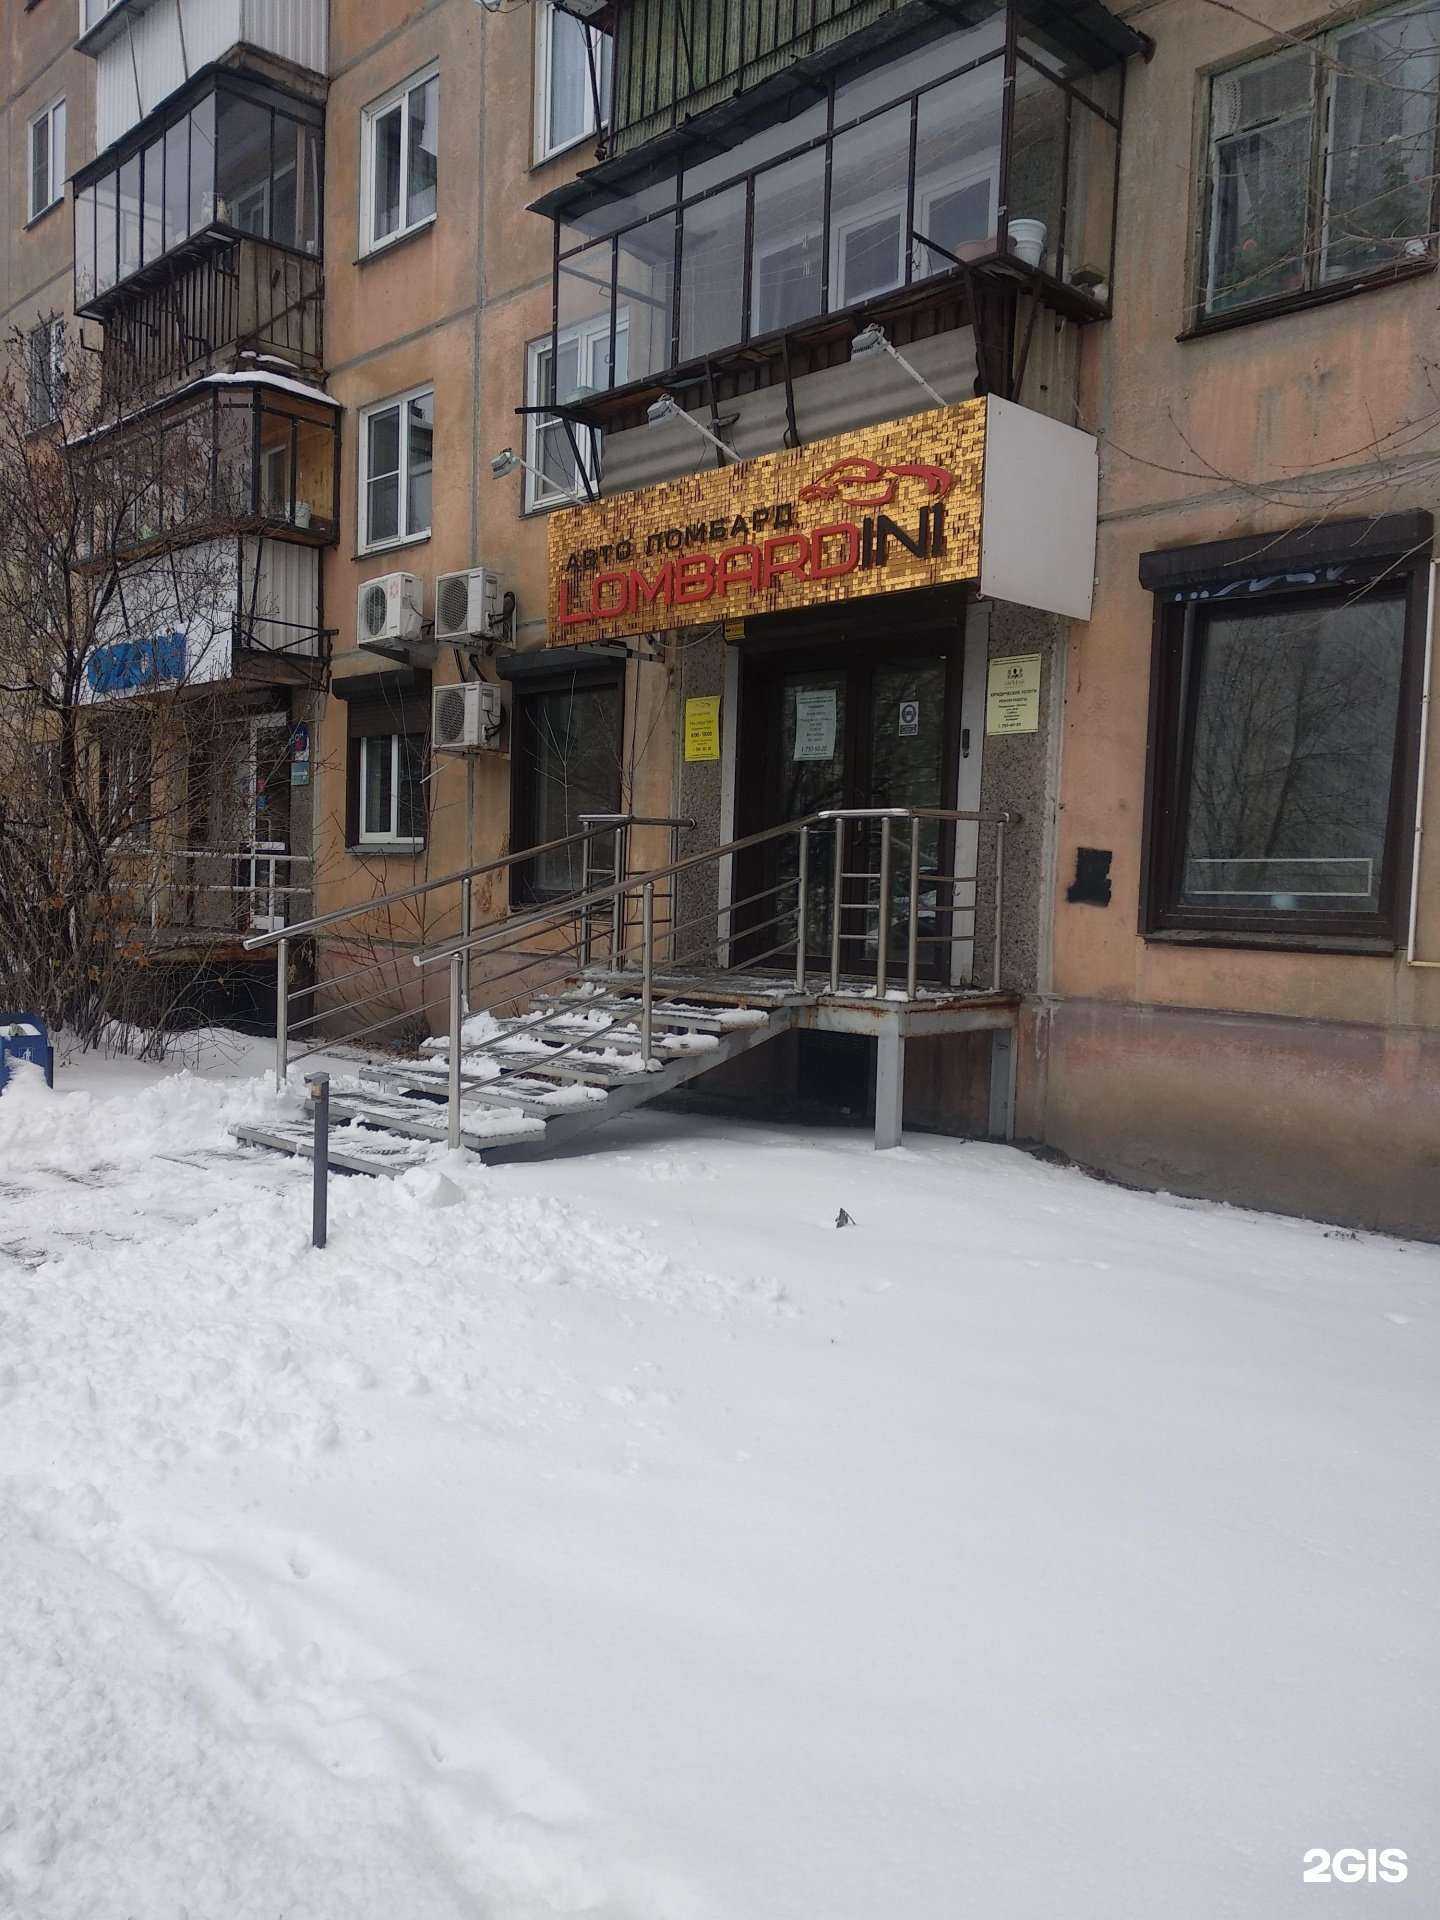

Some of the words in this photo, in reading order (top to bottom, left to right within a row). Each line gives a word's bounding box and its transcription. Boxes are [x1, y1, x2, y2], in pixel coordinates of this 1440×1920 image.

[558, 504, 947, 623] LOMBARDINI
[567, 539, 632, 572] АВТО
[645, 503, 793, 556] ЛОМБАРД
